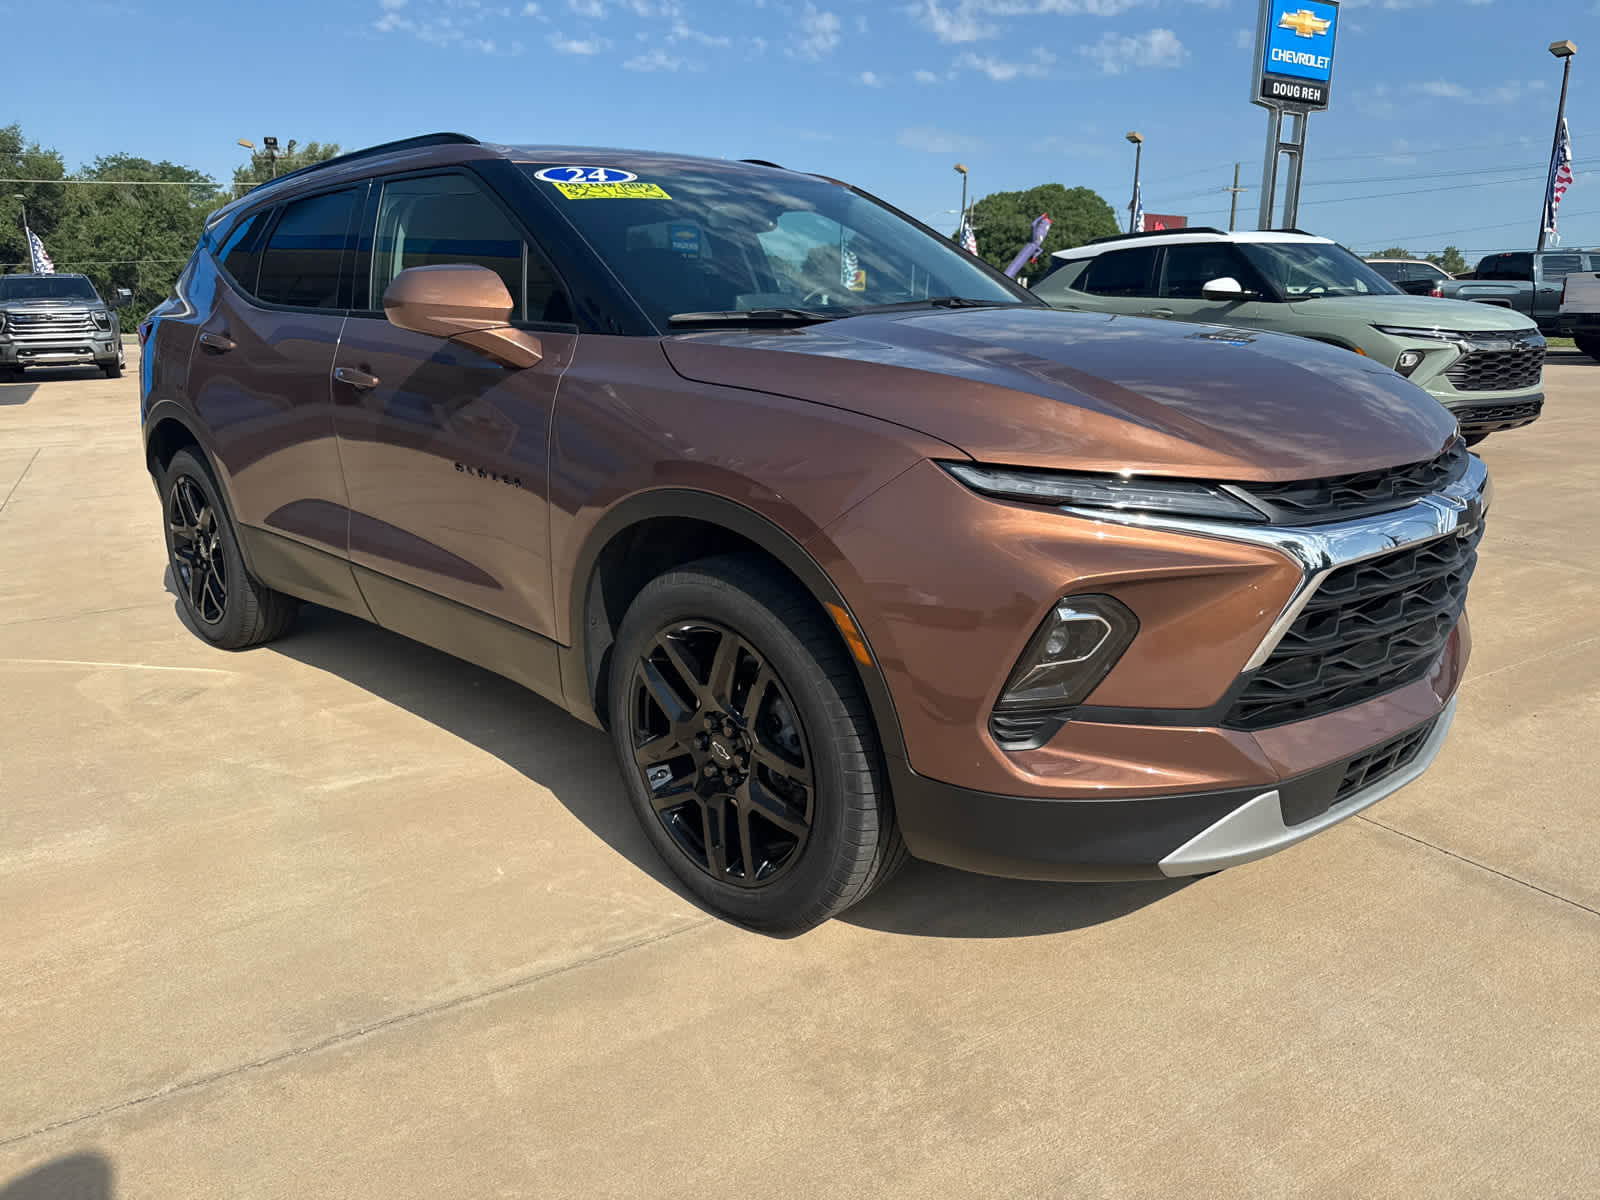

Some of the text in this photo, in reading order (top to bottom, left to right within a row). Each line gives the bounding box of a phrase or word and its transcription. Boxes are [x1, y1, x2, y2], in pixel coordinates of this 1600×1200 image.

[1271, 48, 1331, 69] CHEVROLET
[1273, 82, 1321, 101] DOUG REH
[566, 168, 608, 182] 24
